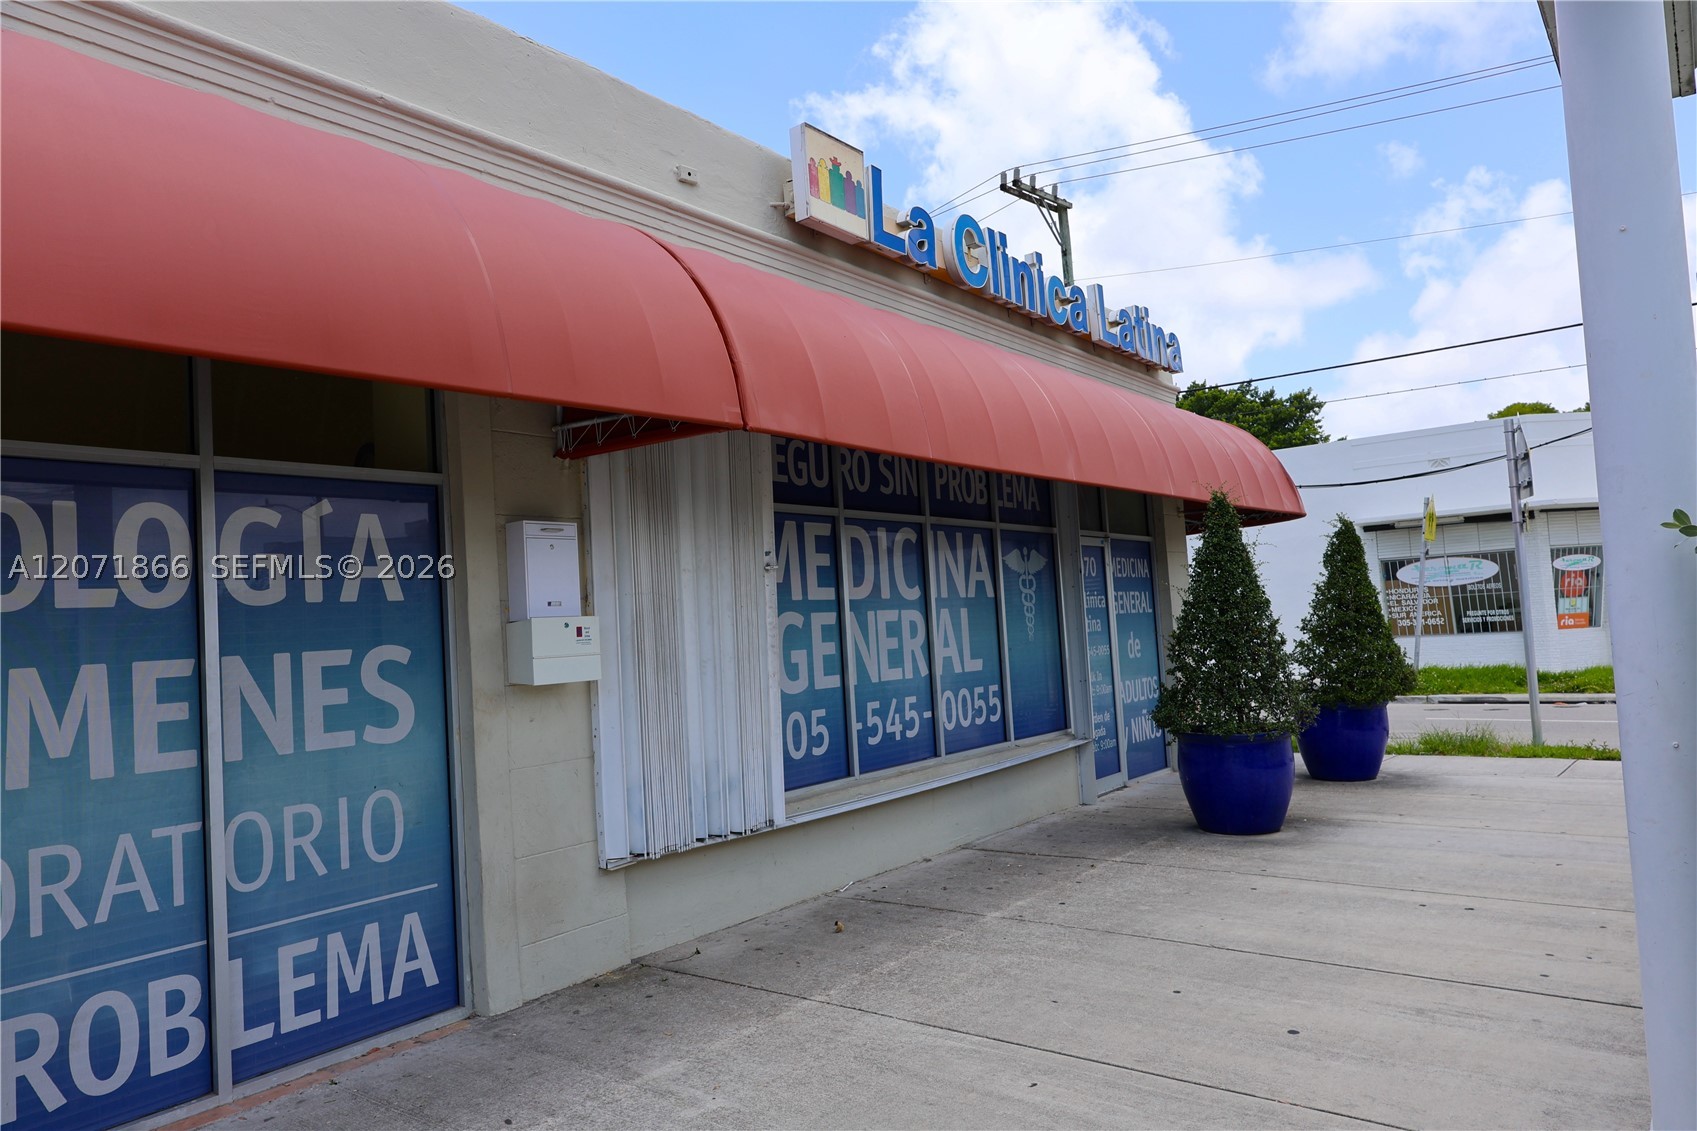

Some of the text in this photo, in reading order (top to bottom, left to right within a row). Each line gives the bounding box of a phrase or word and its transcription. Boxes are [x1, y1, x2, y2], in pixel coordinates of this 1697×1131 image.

[868, 164, 1183, 373] La Clinica Latina
[879, 453, 918, 497] SIN
[1566, 572, 1583, 587] ria
[1401, 598, 1439, 606] SALVDOR
[1560, 615, 1575, 626] ria
[778, 608, 984, 695] GENERAL
[1128, 632, 1142, 659] de
[1120, 676, 1159, 704] ADULTOS
[5, 644, 416, 791] MENES
[2, 912, 440, 1126] ROBLEMA
